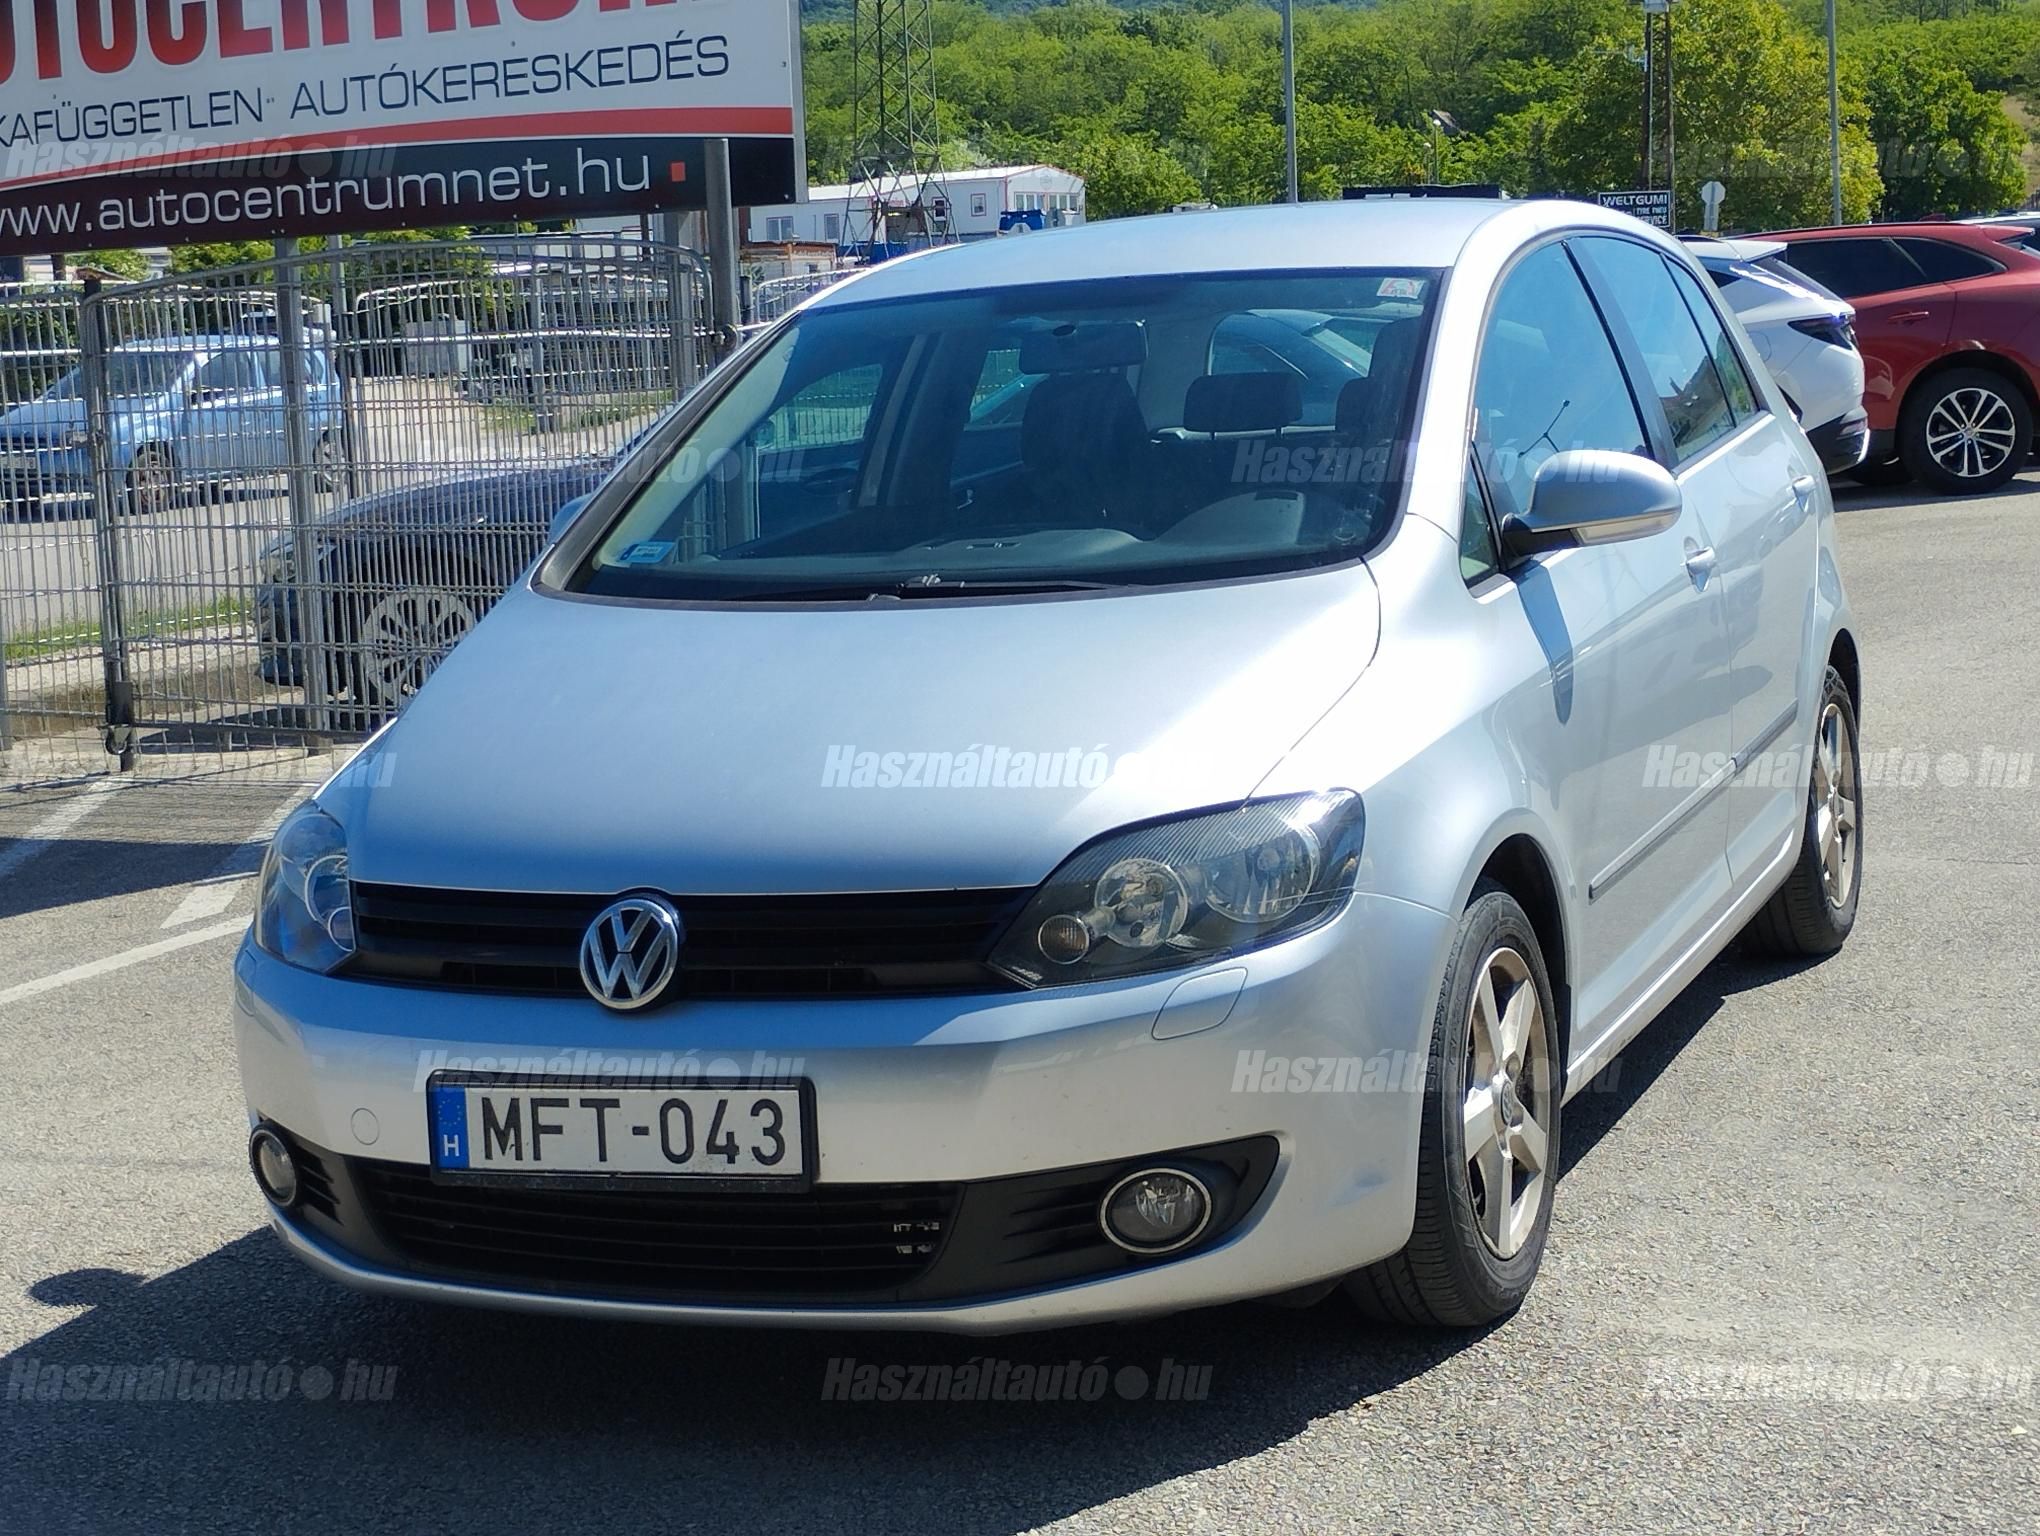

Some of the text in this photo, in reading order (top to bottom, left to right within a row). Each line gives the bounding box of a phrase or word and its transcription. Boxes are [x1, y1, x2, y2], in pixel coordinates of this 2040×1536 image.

[290, 30, 729, 119] AUTÓKERESKEDÉS
[0, 147, 650, 237] ww.autocentrumnet.hu
[1603, 194, 1668, 208] WELTGUMI
[443, 1135, 460, 1157] H
[481, 1097, 786, 1167] MFT-043
